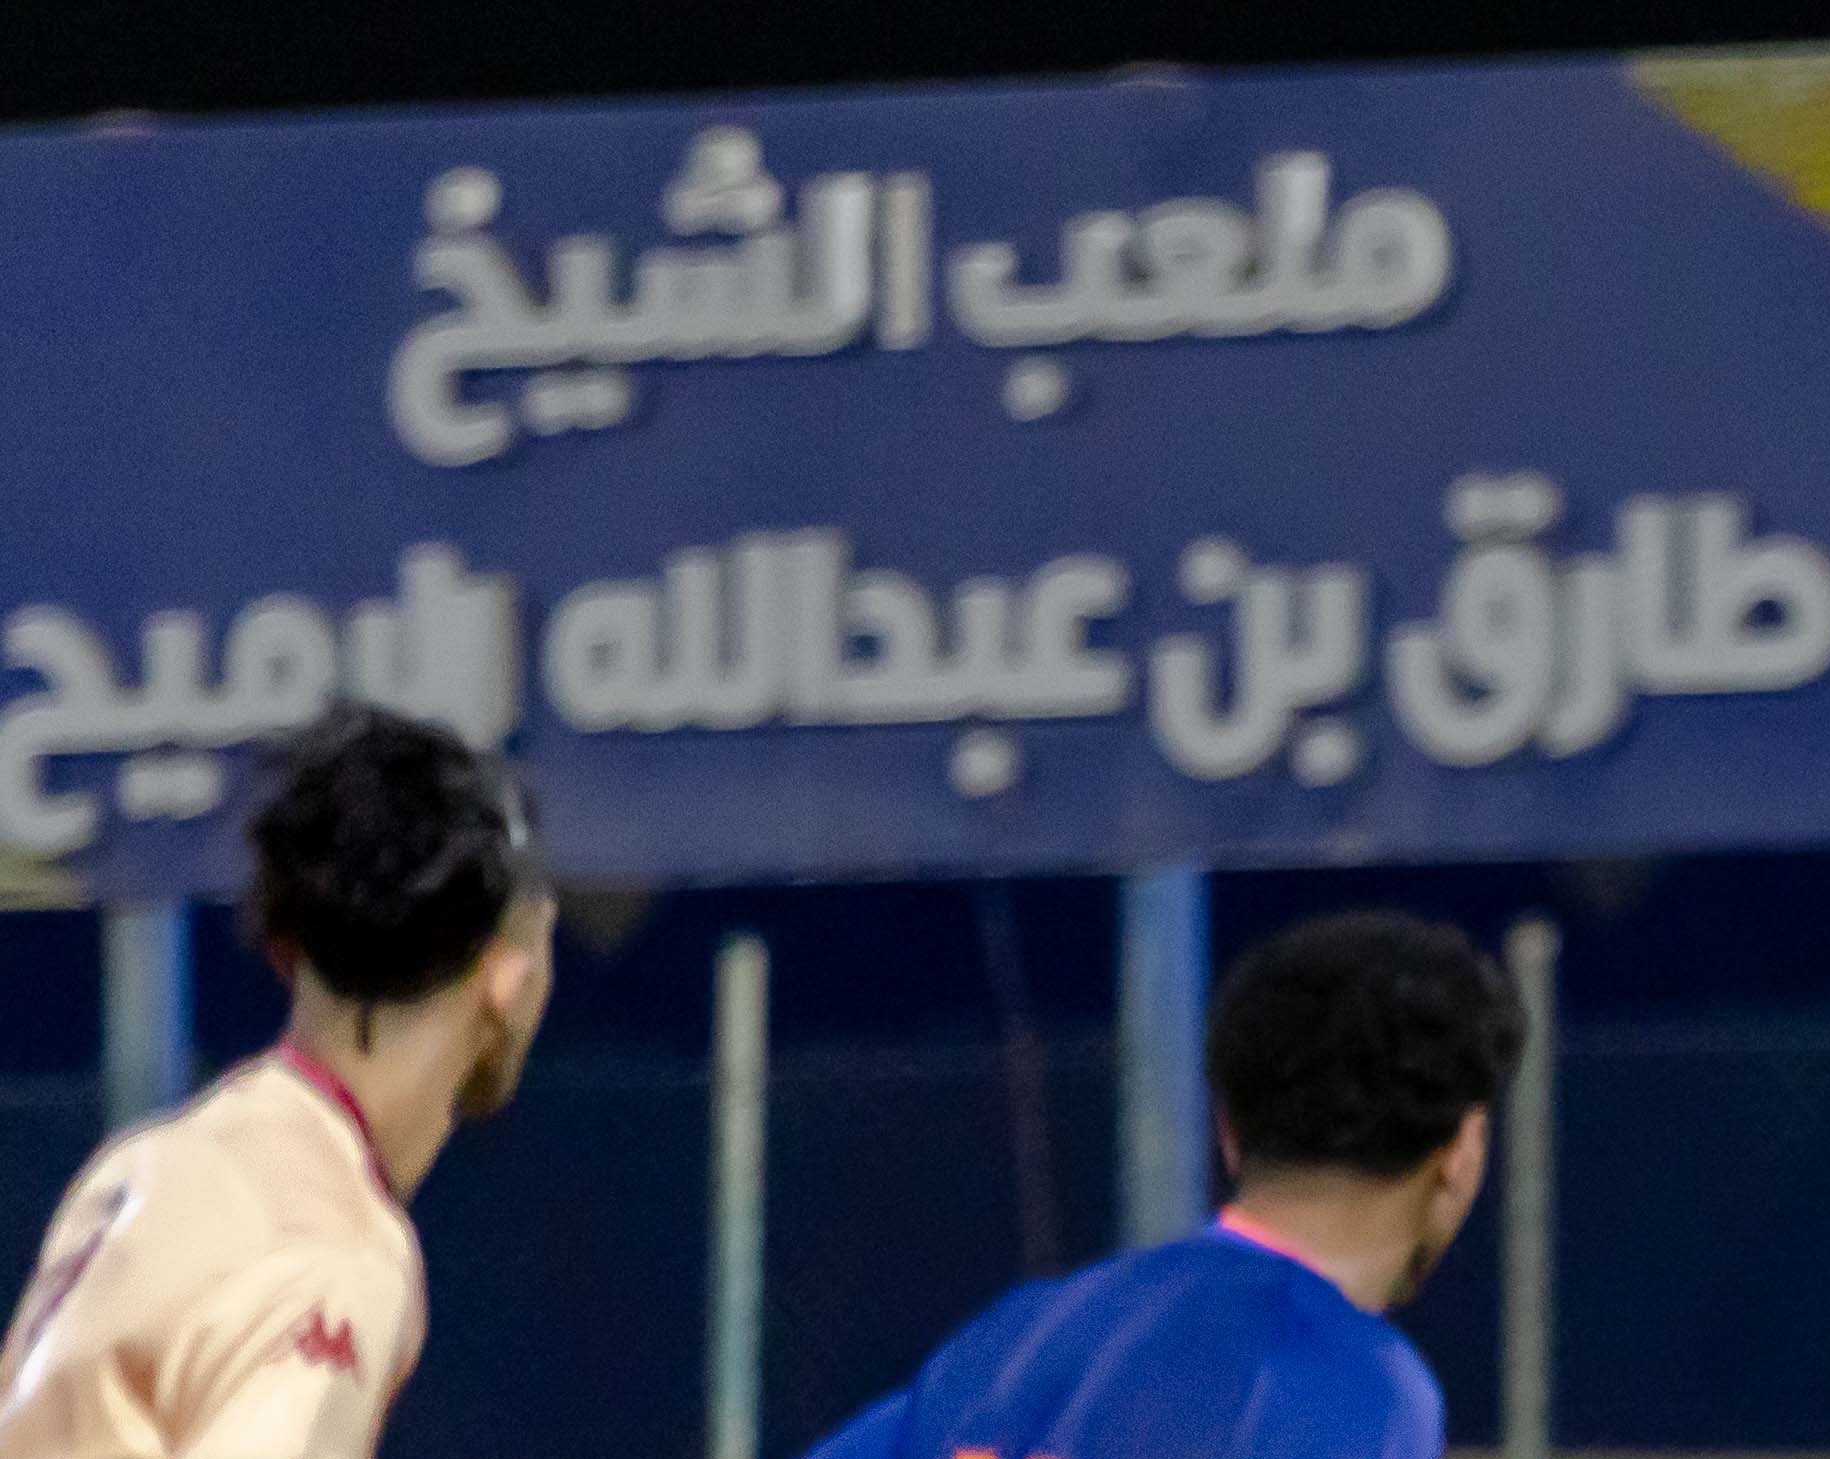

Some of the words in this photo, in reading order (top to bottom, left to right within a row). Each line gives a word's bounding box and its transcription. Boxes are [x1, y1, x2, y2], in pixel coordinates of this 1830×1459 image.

[389, 124, 932, 469] الشيخ
[950, 150, 1453, 421] ملعب
[546, 527, 1132, 796] عبدالله
[1148, 534, 1368, 790] بن
